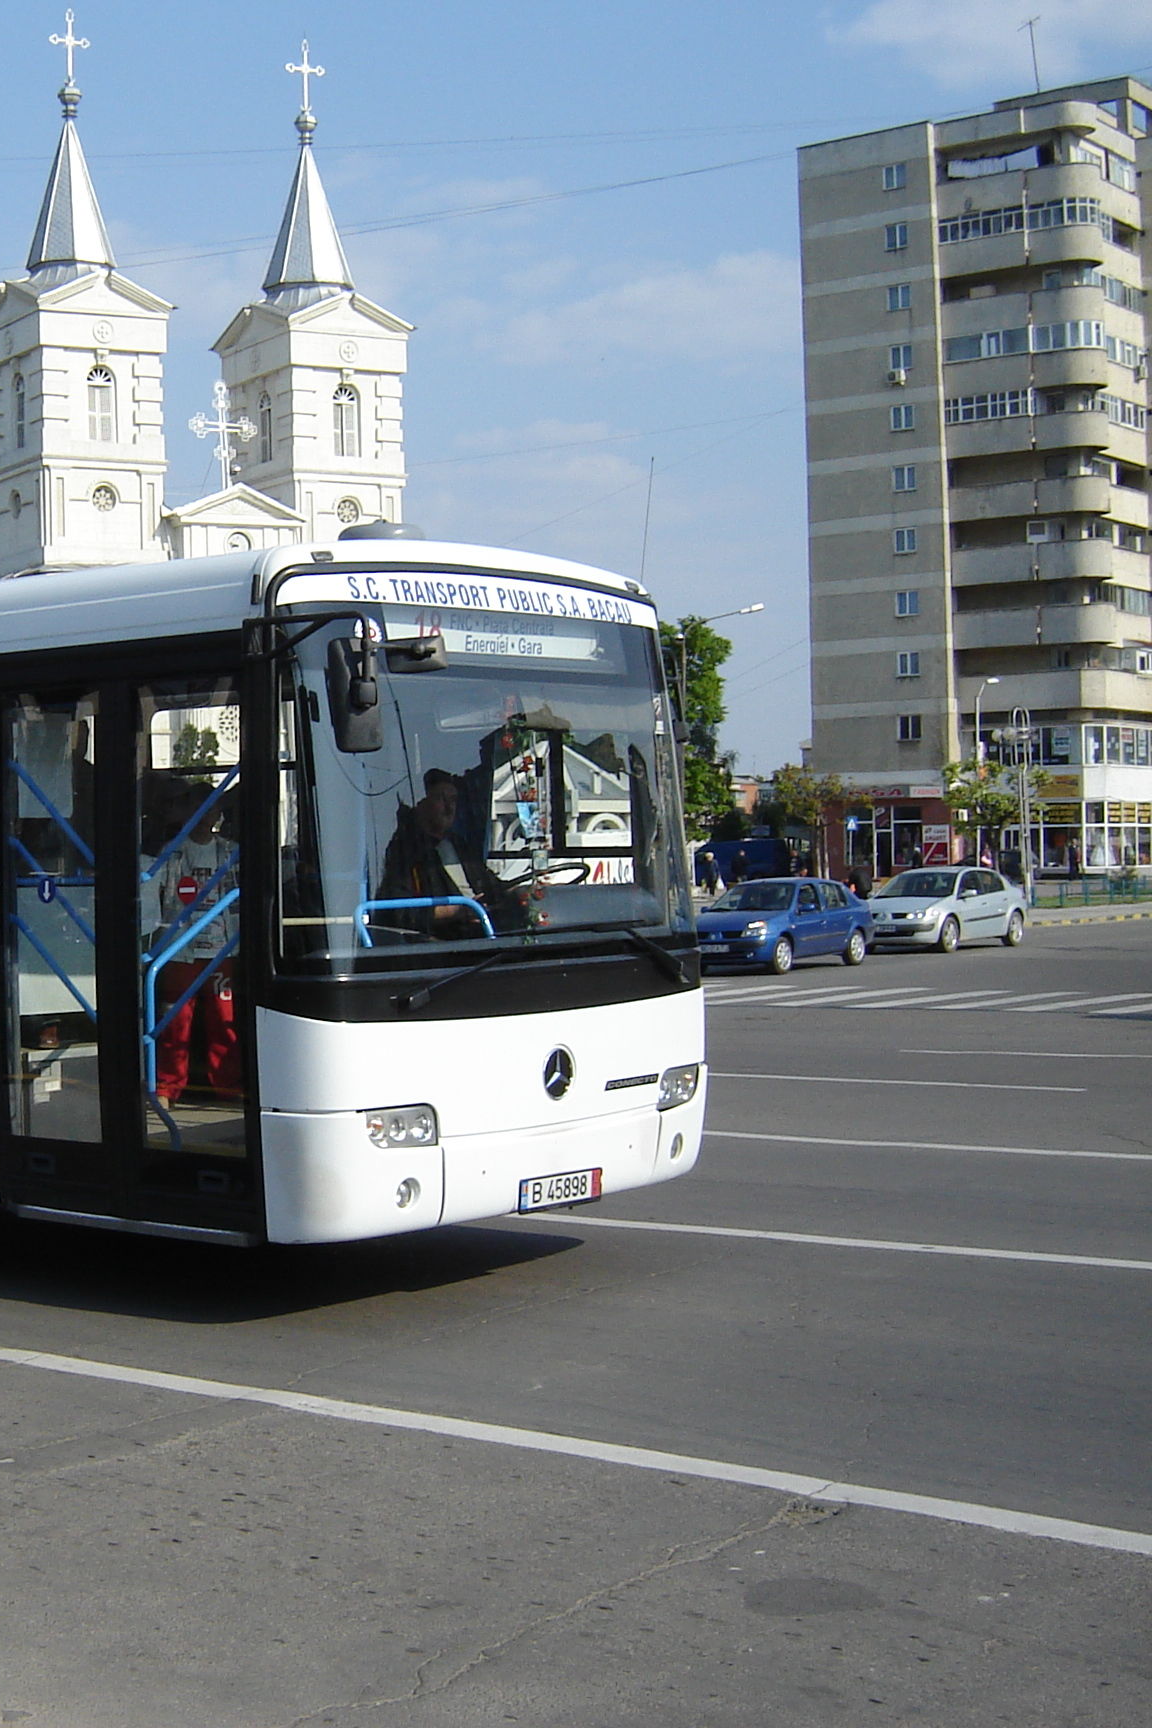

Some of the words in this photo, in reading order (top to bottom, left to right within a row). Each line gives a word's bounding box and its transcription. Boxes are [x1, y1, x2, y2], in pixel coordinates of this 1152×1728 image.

[347, 575, 387, 601] S.C.
[389, 578, 491, 608] TRANSPORT
[497, 587, 554, 615] PUBLIC
[556, 593, 586, 619] S.A.
[587, 597, 633, 625] BACAU
[414, 609, 443, 638] 18
[517, 637, 543, 655] Gara
[532, 1181, 543, 1204] B
[547, 1174, 588, 1201] 45898
